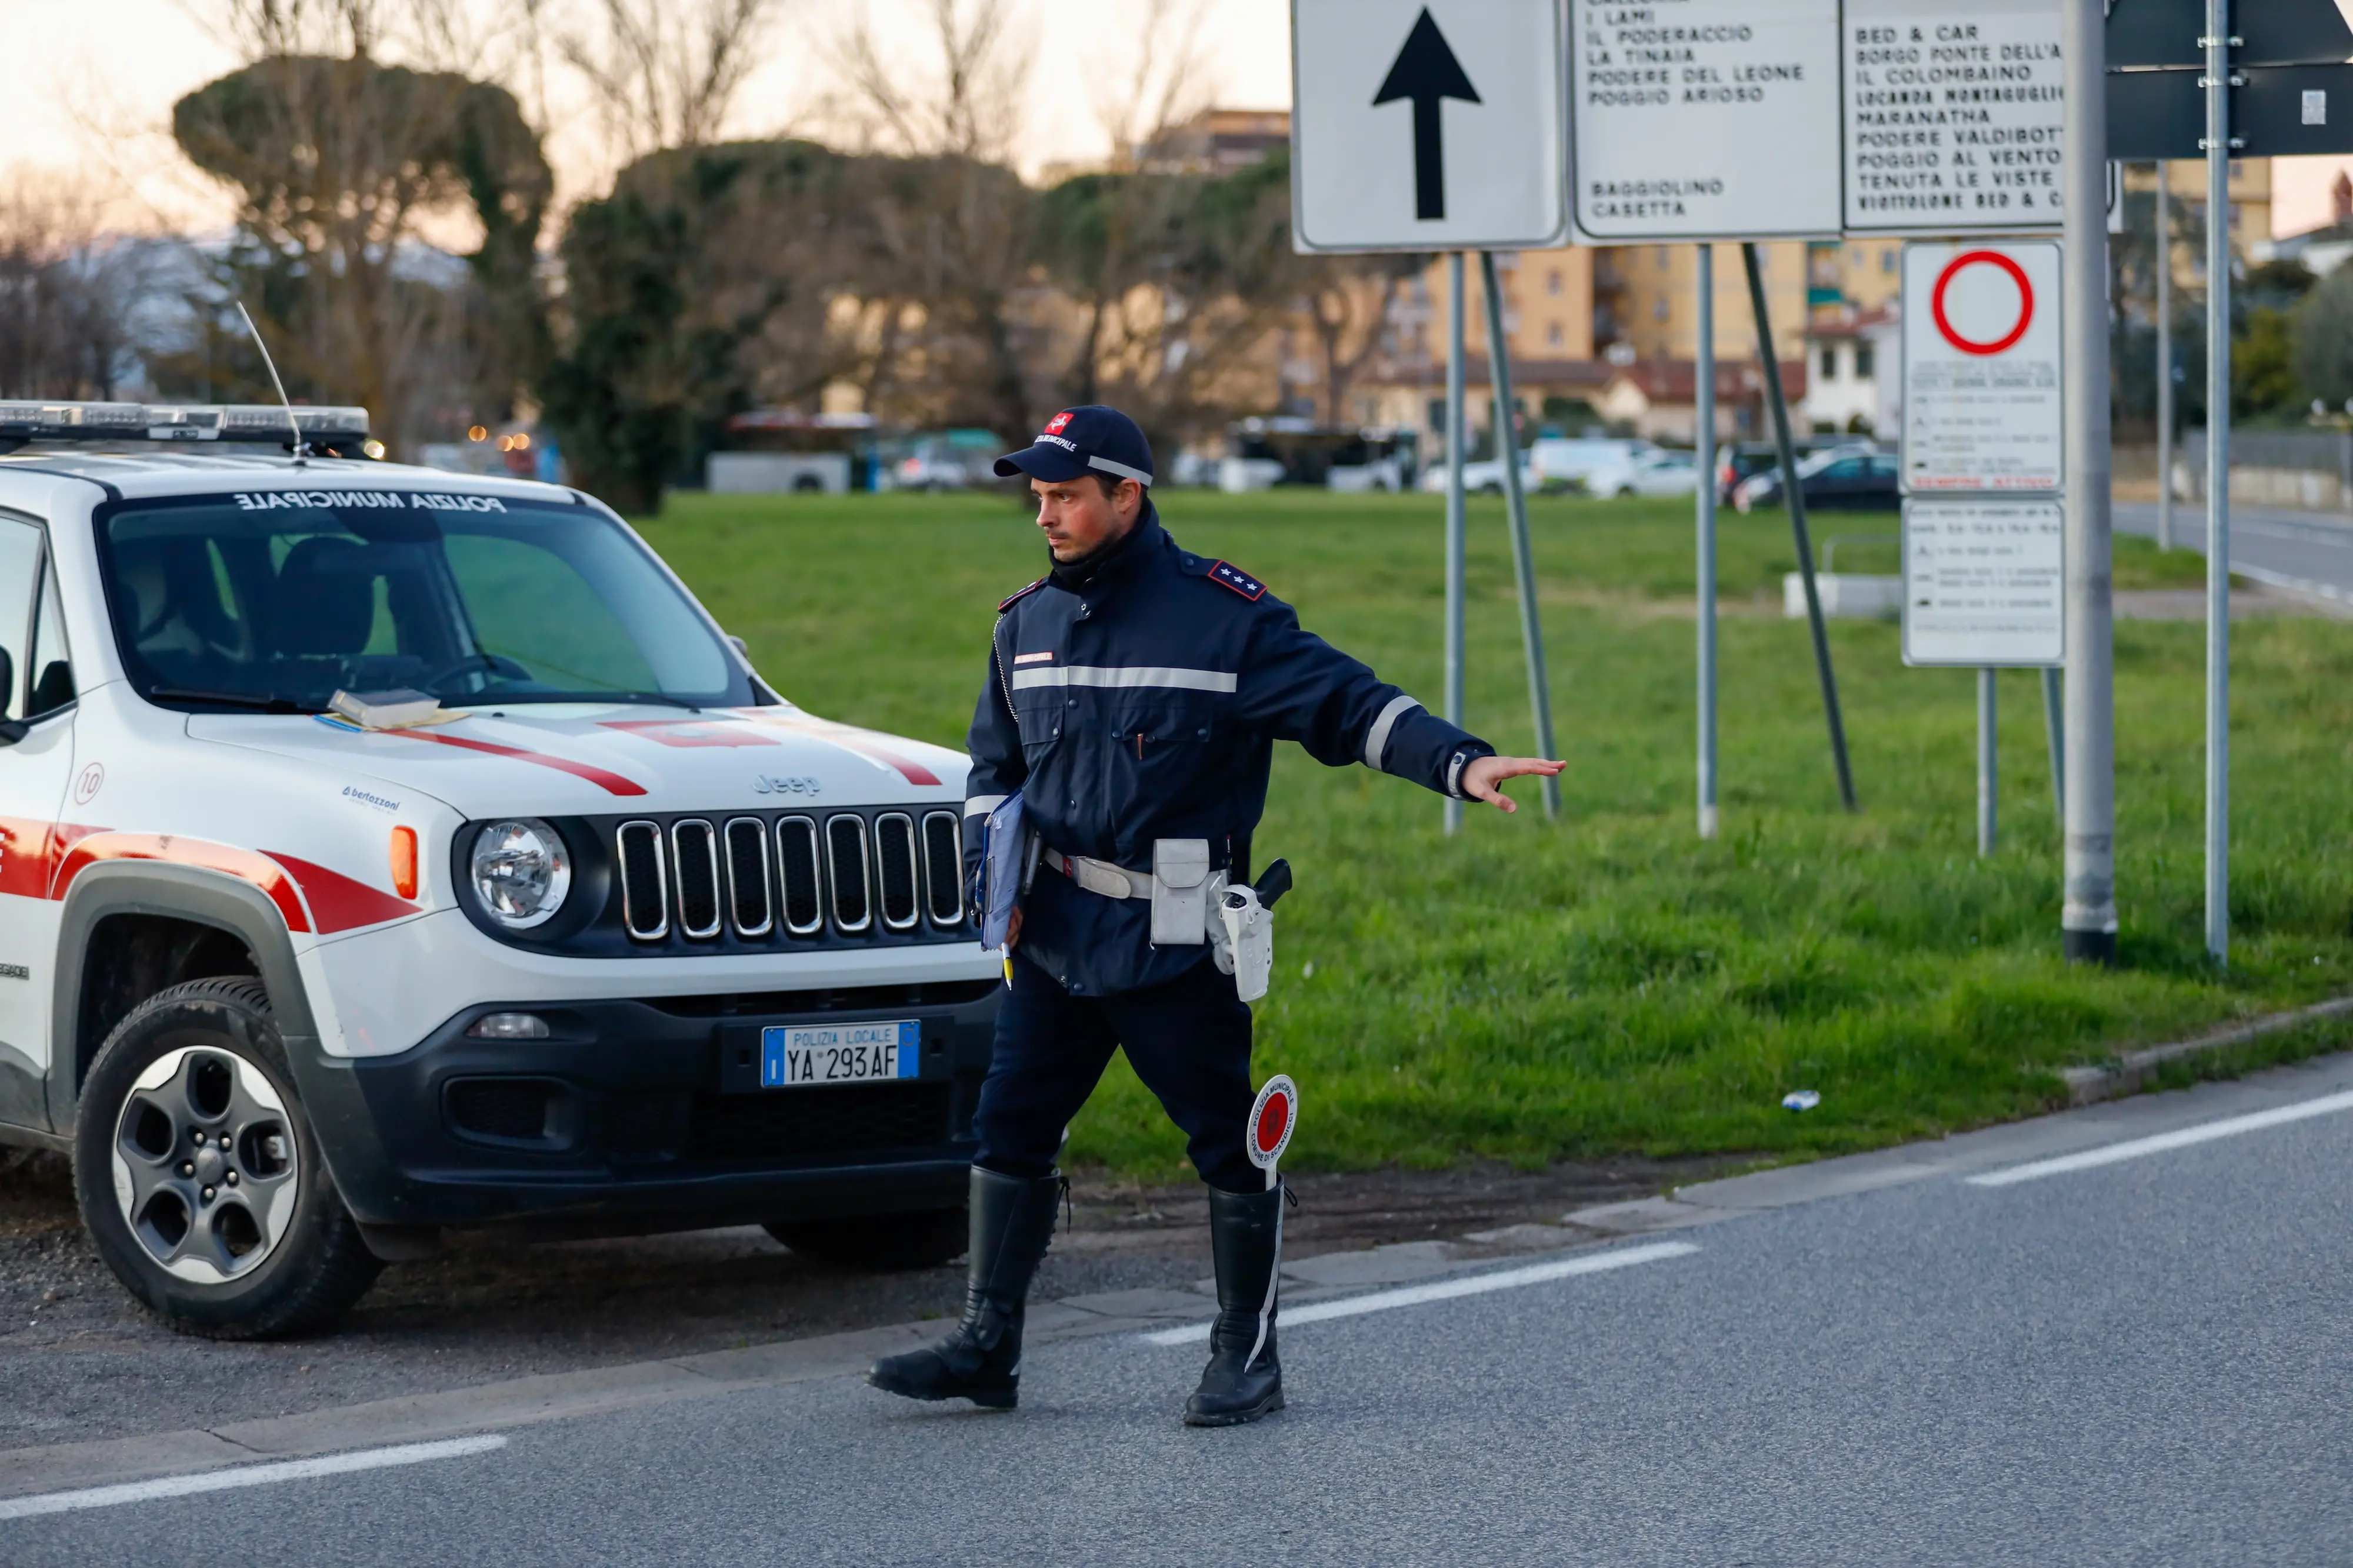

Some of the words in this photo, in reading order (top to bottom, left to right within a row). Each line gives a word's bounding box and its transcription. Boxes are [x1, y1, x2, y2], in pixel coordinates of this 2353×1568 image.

[1618, 25, 1753, 45] PODERACCIO
[1856, 27, 1898, 45] BED
[1909, 26, 1924, 43] &
[1936, 25, 1978, 42] CAR
[1587, 51, 1612, 66] LA
[1855, 48, 1921, 65] BORGO
[1930, 45, 1991, 61] PONTE
[1588, 68, 1671, 86] PODERE
[1682, 67, 1722, 84] DEL
[1734, 64, 1805, 82] LEONE
[1855, 69, 1874, 86] IL
[1885, 65, 2032, 85] COLOMBAINO
[1588, 89, 1671, 106] POGGIO
[1682, 86, 1765, 104] ARIOSO
[1857, 90, 1934, 107] LOCANDA
[1856, 108, 1991, 126] MARANATHA
[1857, 131, 1941, 148] PODERE
[1857, 151, 1940, 169] POGGIO
[1952, 150, 1977, 166] AL
[1989, 148, 2062, 166] VENTO
[1591, 179, 1725, 198] BAGGIOLINO
[1859, 172, 1942, 190] TENUTA
[1955, 171, 1980, 188] LE
[1992, 169, 2053, 187] VISTE
[1592, 201, 1687, 218] CASETTA
[1857, 194, 1963, 211] VIOTTOLONE
[1975, 192, 2009, 208] BED
[2021, 192, 2035, 207] &
[80, 772, 100, 794] 10
[752, 775, 821, 796] Jeep
[351, 788, 401, 811] bertazzoni
[794, 1032, 838, 1046] POLIZIA
[846, 1029, 892, 1044] LOCALE
[788, 1049, 814, 1081] YA
[1253, 1092, 1269, 1126] POLIZIA
[1269, 1082, 1294, 1106] MUNICIPALE
[1251, 1133, 1264, 1162] COMUNE
[1264, 1153, 1270, 1162] DI
[1271, 1112, 1294, 1159] SCANDICCI
